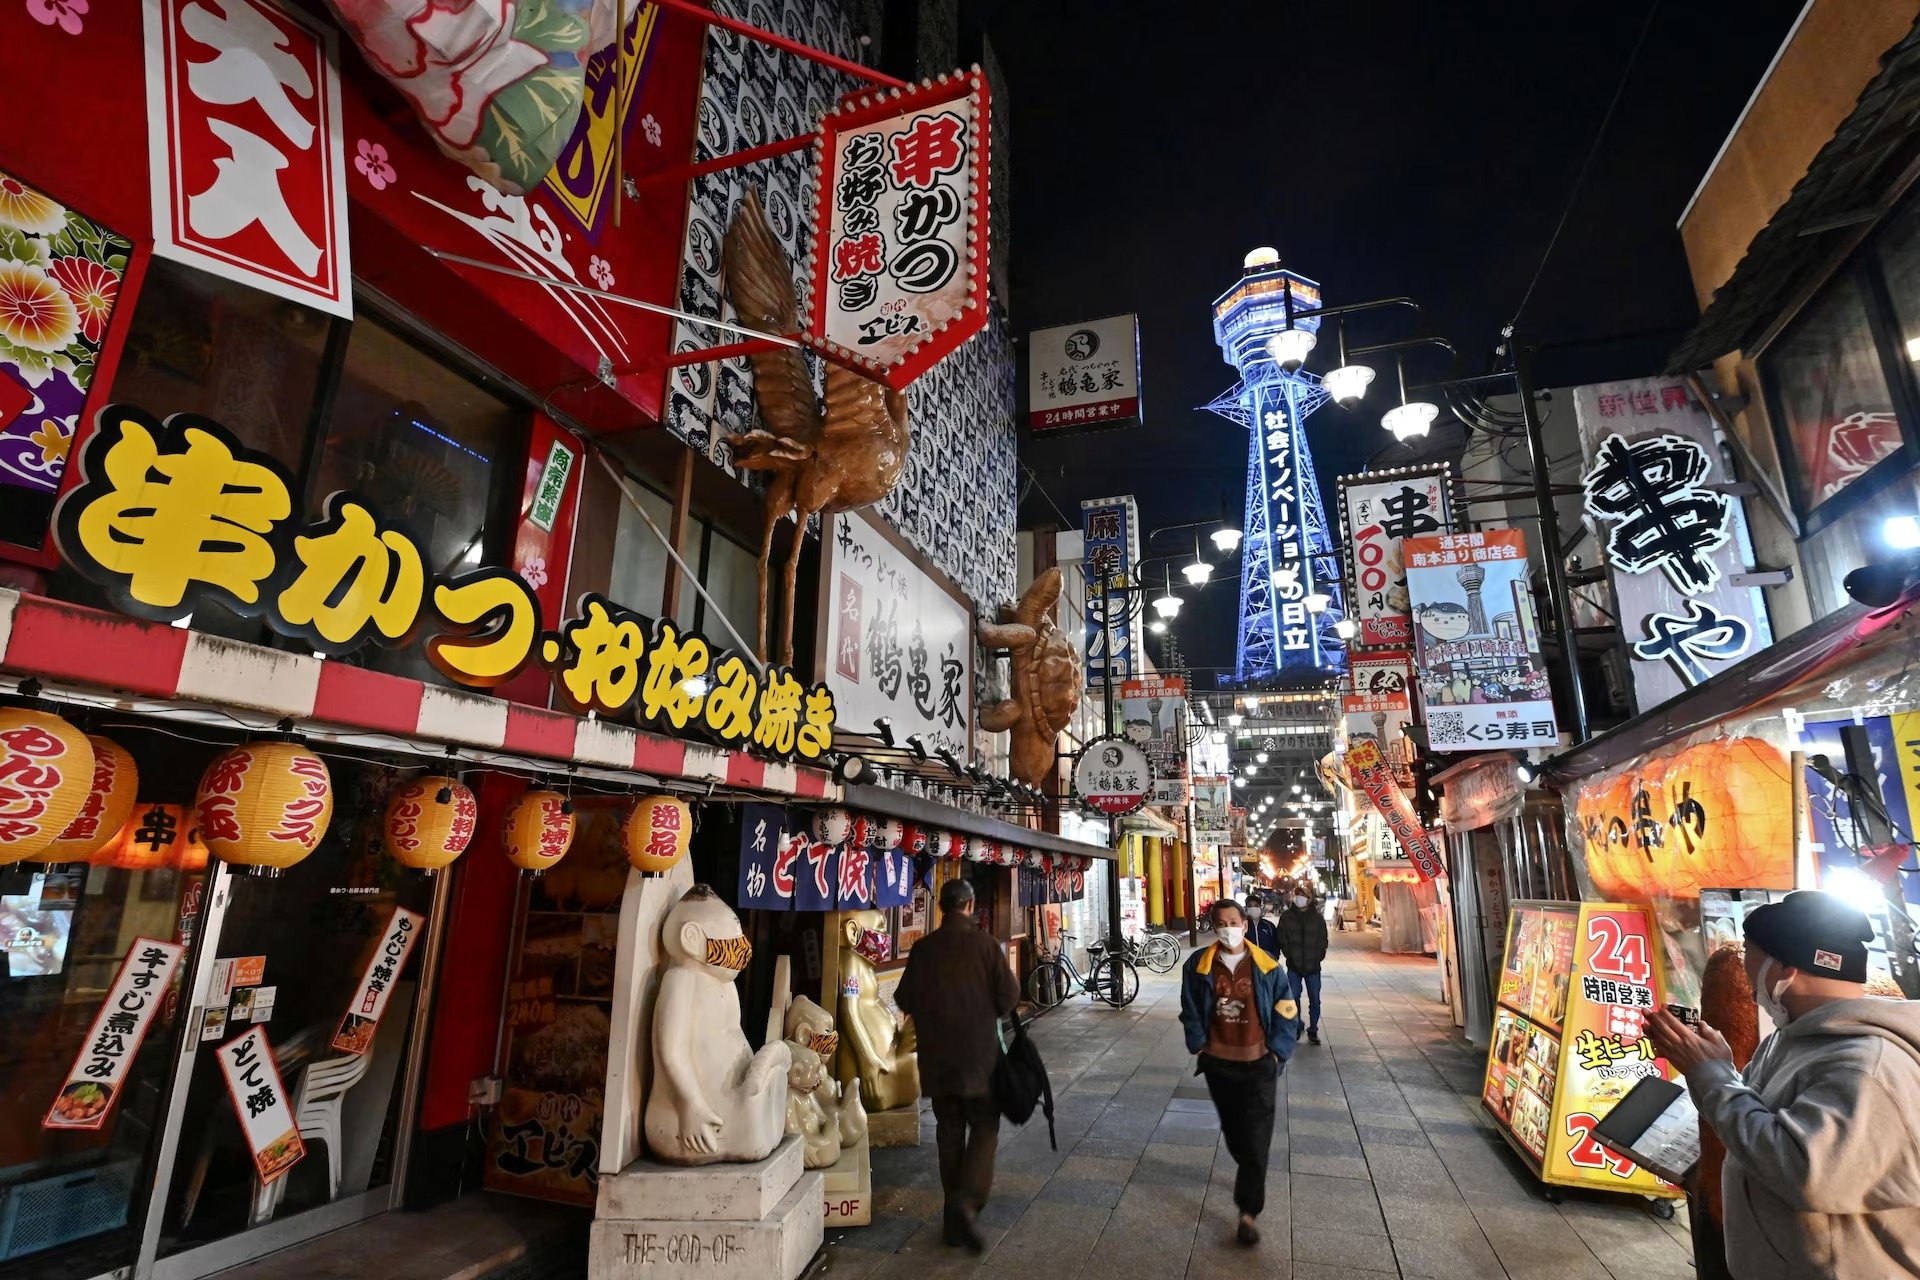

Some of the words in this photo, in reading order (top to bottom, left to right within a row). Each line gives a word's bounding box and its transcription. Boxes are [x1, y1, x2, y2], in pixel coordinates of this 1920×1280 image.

[832, 133, 886, 312] お好み焼き
[889, 112, 968, 294] 串かつ
[858, 314, 922, 345] エビス
[1045, 404, 1121, 424] 24時間営業中
[1058, 368, 1124, 396] 鶴亀家
[837, 512, 873, 570] 串かつ
[1086, 509, 1123, 577] 麻雀
[1379, 486, 1440, 541] 串
[1439, 532, 1485, 549] 通天閣
[1412, 545, 1517, 567] 南本通り商店会
[841, 588, 860, 674] 名代
[865, 597, 967, 730] 鶴亀家
[1125, 688, 1181, 698] 南本通り商店会
[1348, 701, 1405, 712] 南本通り商店会
[1466, 720, 1557, 742] くら寿司
[269, 757, 328, 848] ミックス
[746, 818, 768, 899] 名物
[773, 830, 870, 904] どて焼
[368, 916, 416, 992] もんじゃ焼き
[1588, 916, 1651, 984] 24
[84, 947, 169, 1078] 牛すじ煮込み
[1582, 976, 1654, 1009] 時間営業
[232, 1034, 278, 1119] どて焼
[1576, 1030, 1657, 1070] 生ビール
[496, 1118, 600, 1183] エビス
